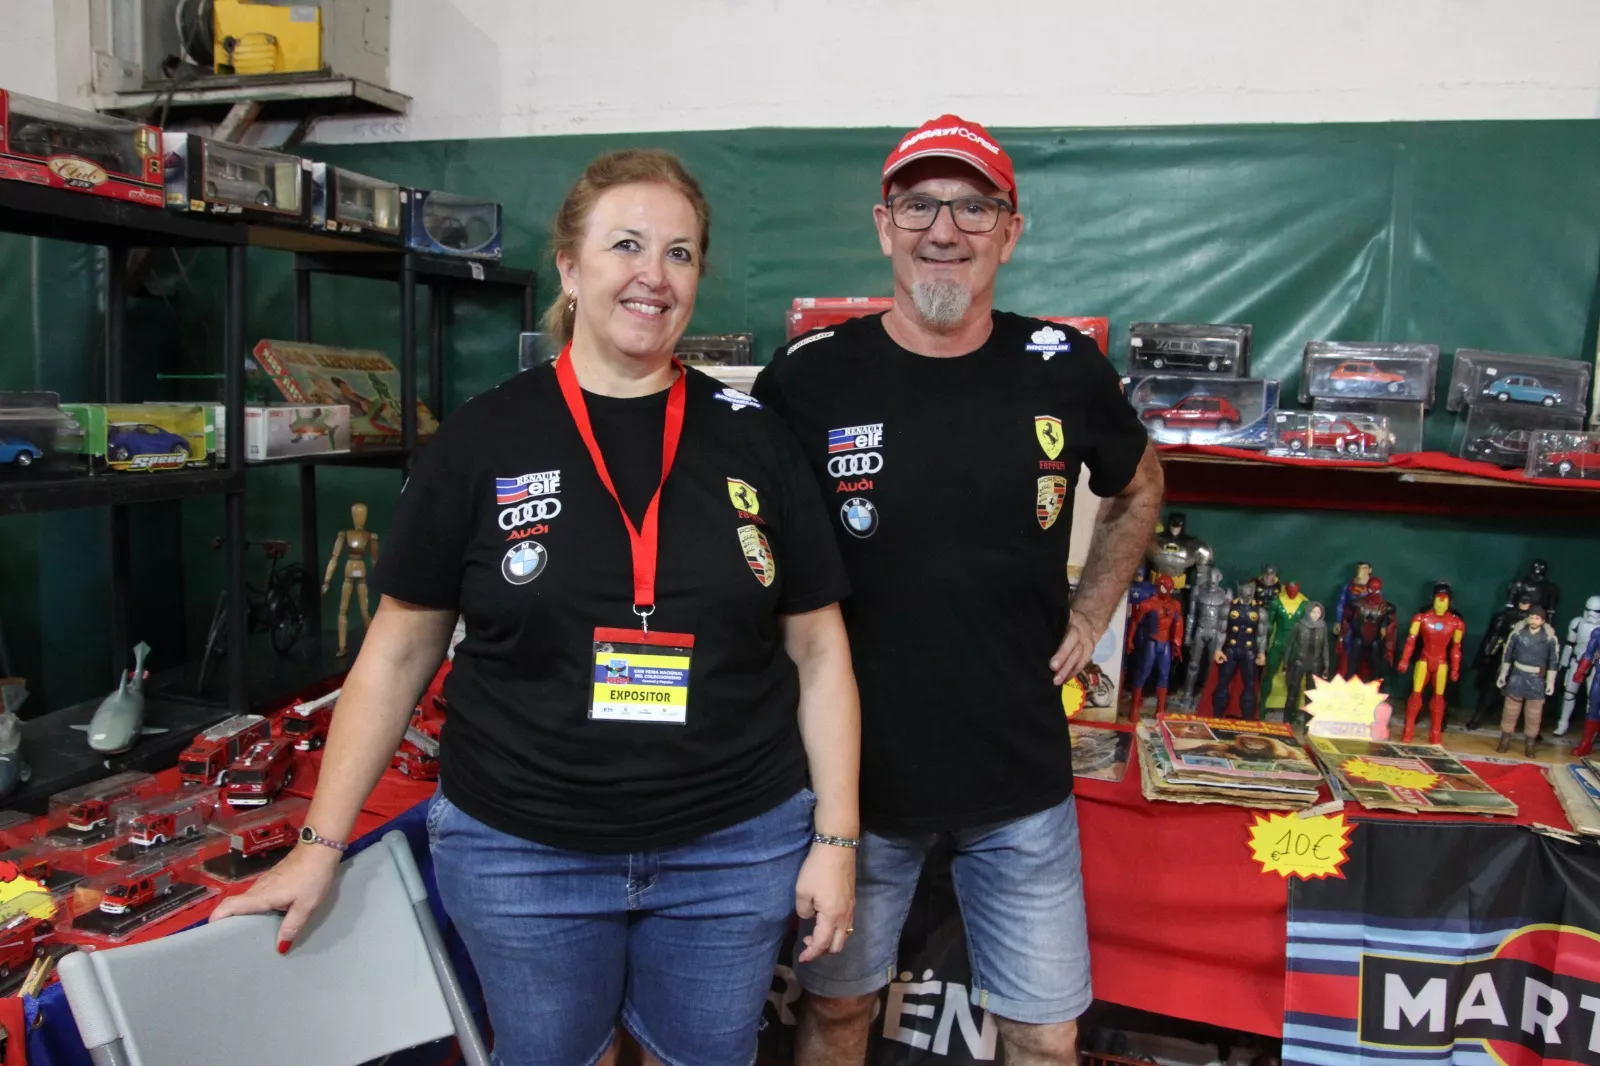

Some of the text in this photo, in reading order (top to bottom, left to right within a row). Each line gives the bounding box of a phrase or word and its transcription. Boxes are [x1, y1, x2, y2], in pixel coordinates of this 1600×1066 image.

[714, 393, 761, 408] MICHELIN
[844, 423, 883, 436] RENAULT
[855, 433, 883, 448] elf
[516, 470, 561, 486] RENAULT
[528, 479, 561, 496] elf
[507, 543, 544, 559] BMW
[610, 689, 671, 703] EXPOSITOR
